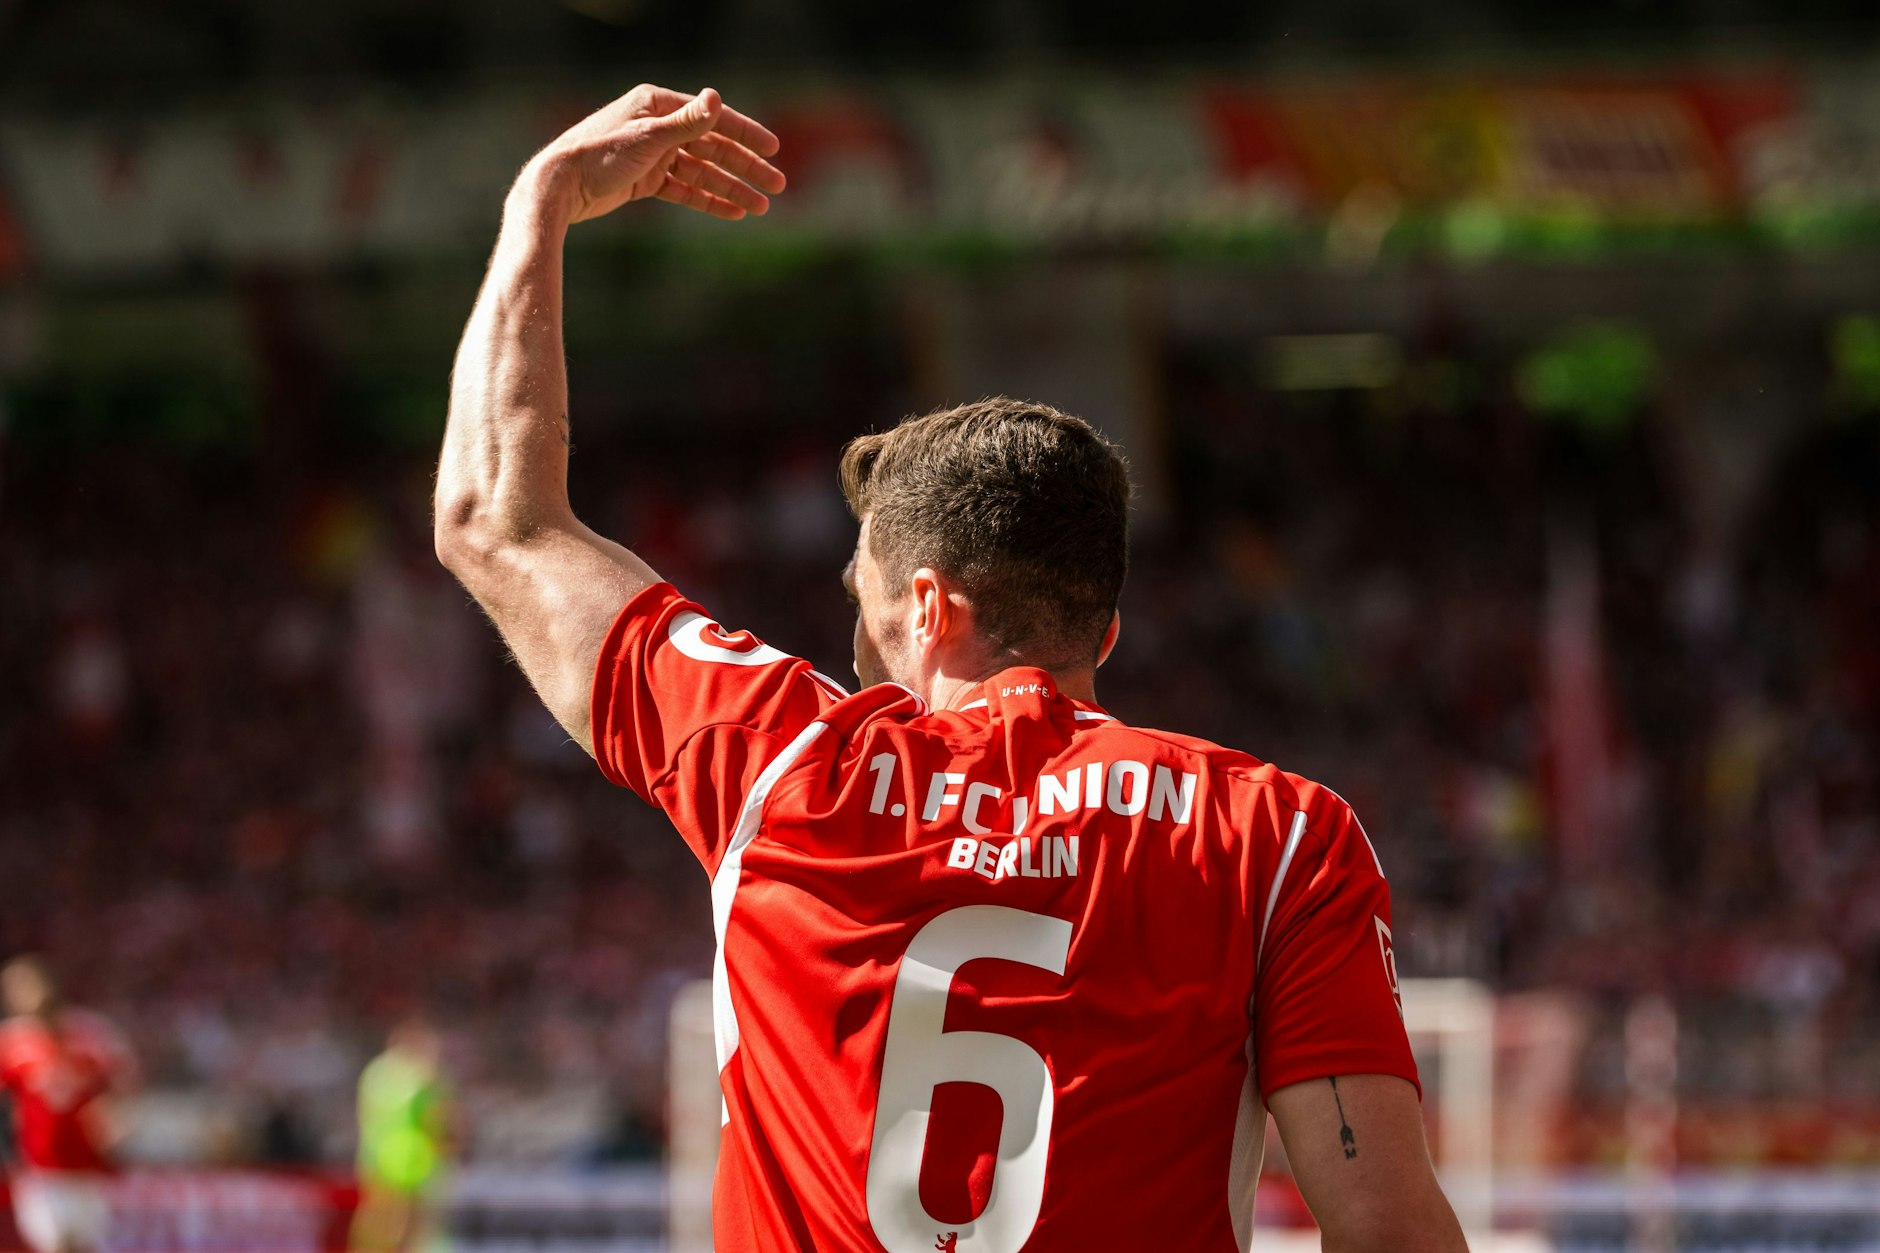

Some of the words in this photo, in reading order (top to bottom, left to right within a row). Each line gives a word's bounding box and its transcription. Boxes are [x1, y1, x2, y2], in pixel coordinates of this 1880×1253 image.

[868, 752, 906, 817] 1.
[921, 772, 1002, 836] FC
[946, 835, 1080, 880] BERLIN
[866, 904, 1074, 1253] 6
